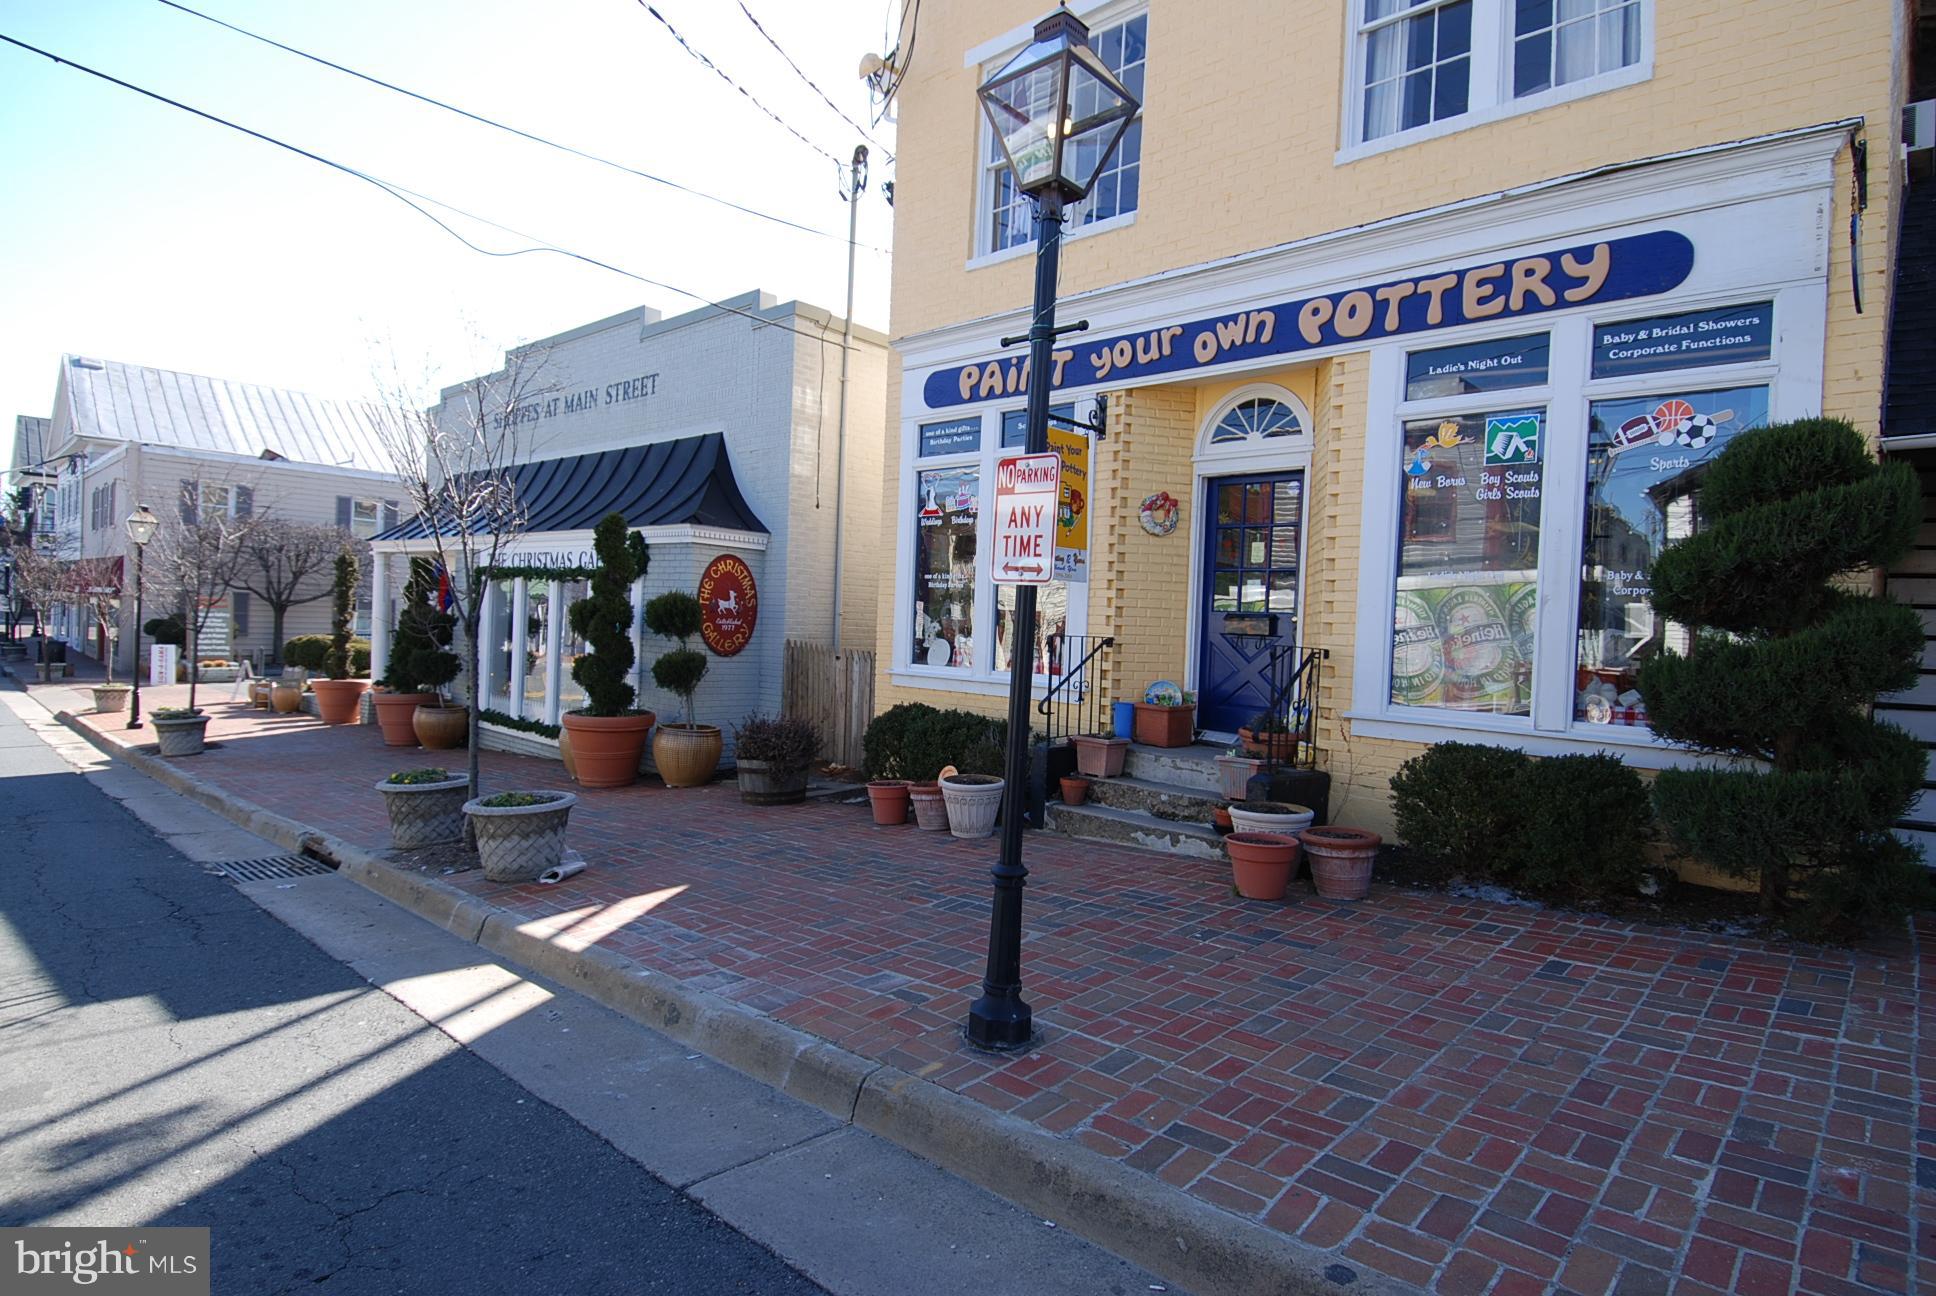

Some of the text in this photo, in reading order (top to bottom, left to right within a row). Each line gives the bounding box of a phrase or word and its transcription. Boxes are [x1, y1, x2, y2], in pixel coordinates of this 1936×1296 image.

[1298, 242, 1611, 344] POTTERY
[1603, 316, 1760, 345] Baby & Bridal Showers
[1609, 334, 1752, 359] Corporate Functions
[1429, 354, 1523, 375] Ladie's Night Out
[493, 373, 660, 430] SPPES AT MAIN STREET
[929, 437, 952, 446] Birthday
[1065, 443, 1082, 457] Your
[1061, 459, 1087, 481] Pottery
[1651, 456, 1690, 472] Sports
[998, 464, 1055, 489] NO PARKING
[1436, 475, 1466, 488] Borns
[1480, 470, 1539, 487] Boy Scouts
[1476, 486, 1540, 500] Girls Scouts
[1008, 504, 1045, 529] ANY
[1003, 535, 1043, 558] TIME
[511, 550, 573, 569] CHRISTMAS
[699, 559, 756, 607] THE CHRISTMAS
[1607, 570, 1644, 583] Baby &
[702, 622, 749, 651] GALLERY
